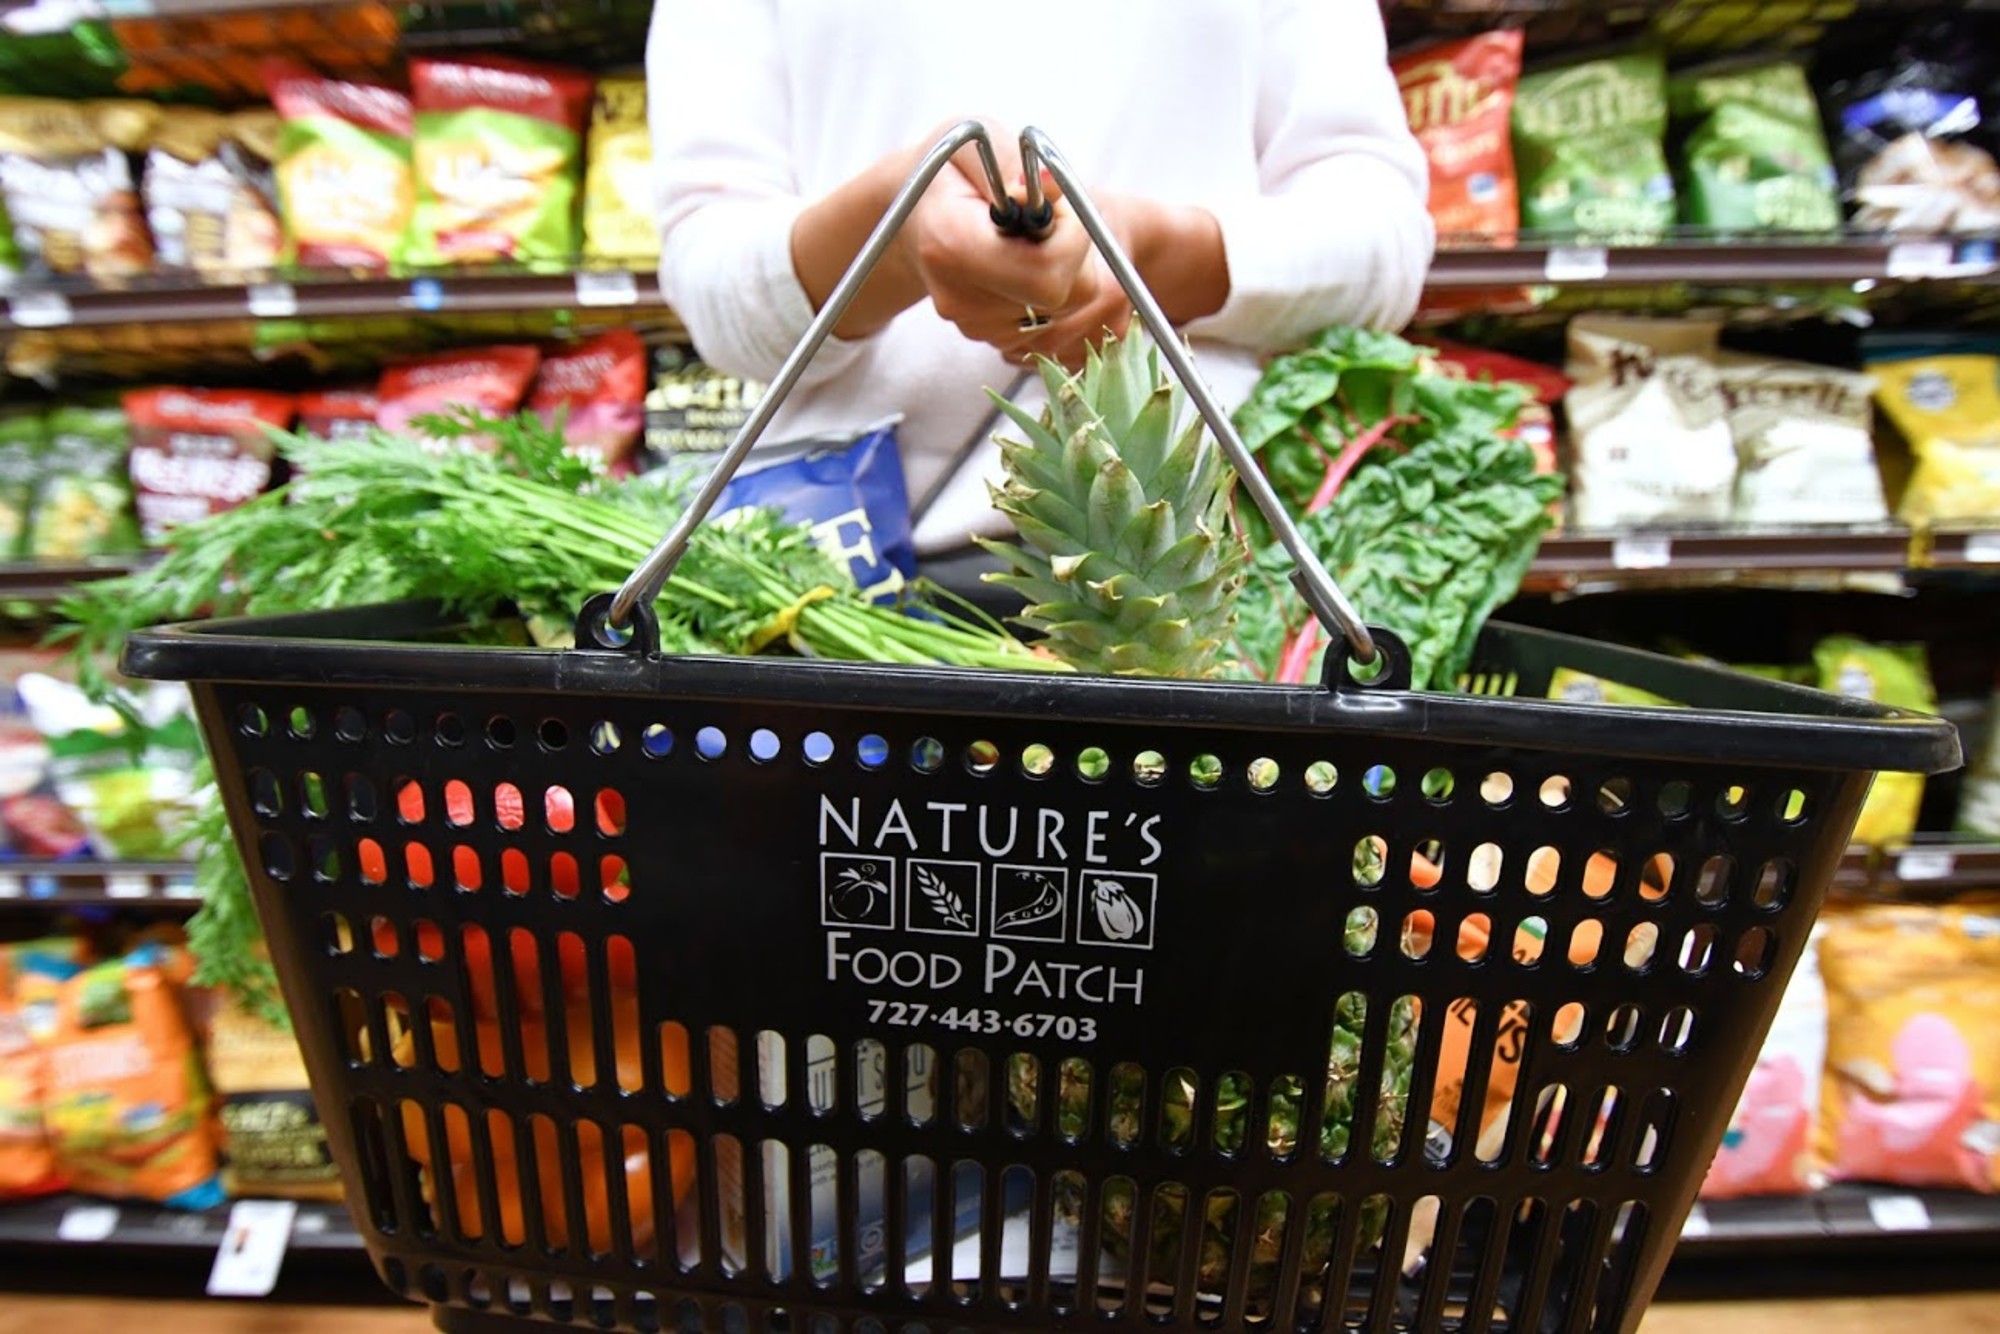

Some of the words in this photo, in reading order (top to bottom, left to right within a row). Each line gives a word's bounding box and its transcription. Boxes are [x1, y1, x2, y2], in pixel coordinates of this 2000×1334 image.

[819, 794, 1162, 867] NATURE'S
[826, 931, 963, 990] FOOD
[984, 943, 1144, 1006] PATCH
